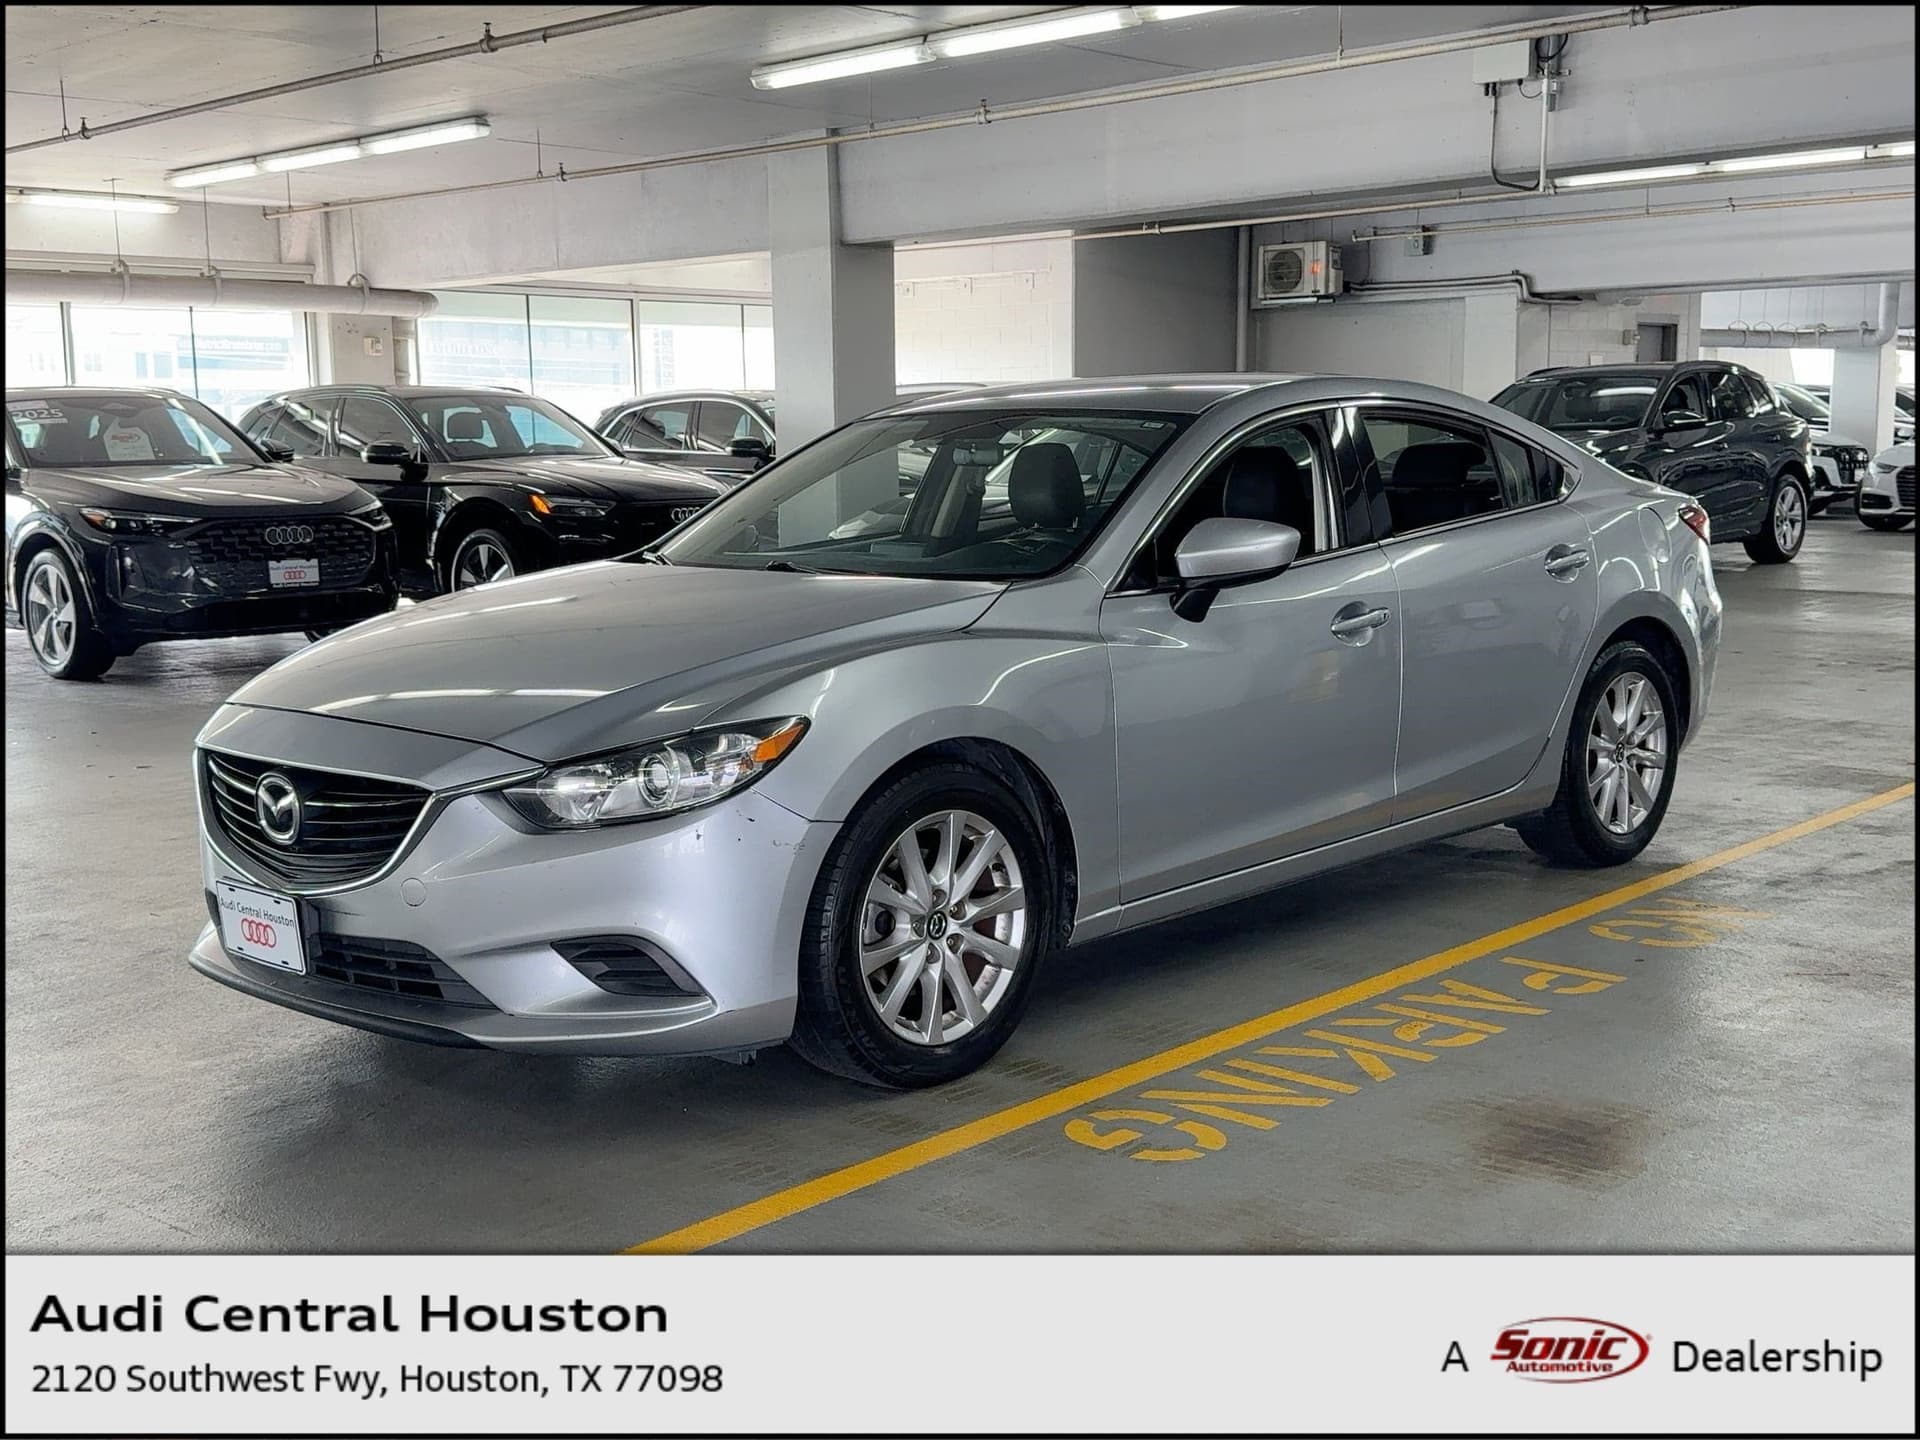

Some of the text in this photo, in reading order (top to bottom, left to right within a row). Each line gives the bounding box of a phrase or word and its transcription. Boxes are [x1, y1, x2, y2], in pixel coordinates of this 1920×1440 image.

[219, 895, 295, 928] Audi Central Houston
[1064, 956, 1627, 1161] PARKING
